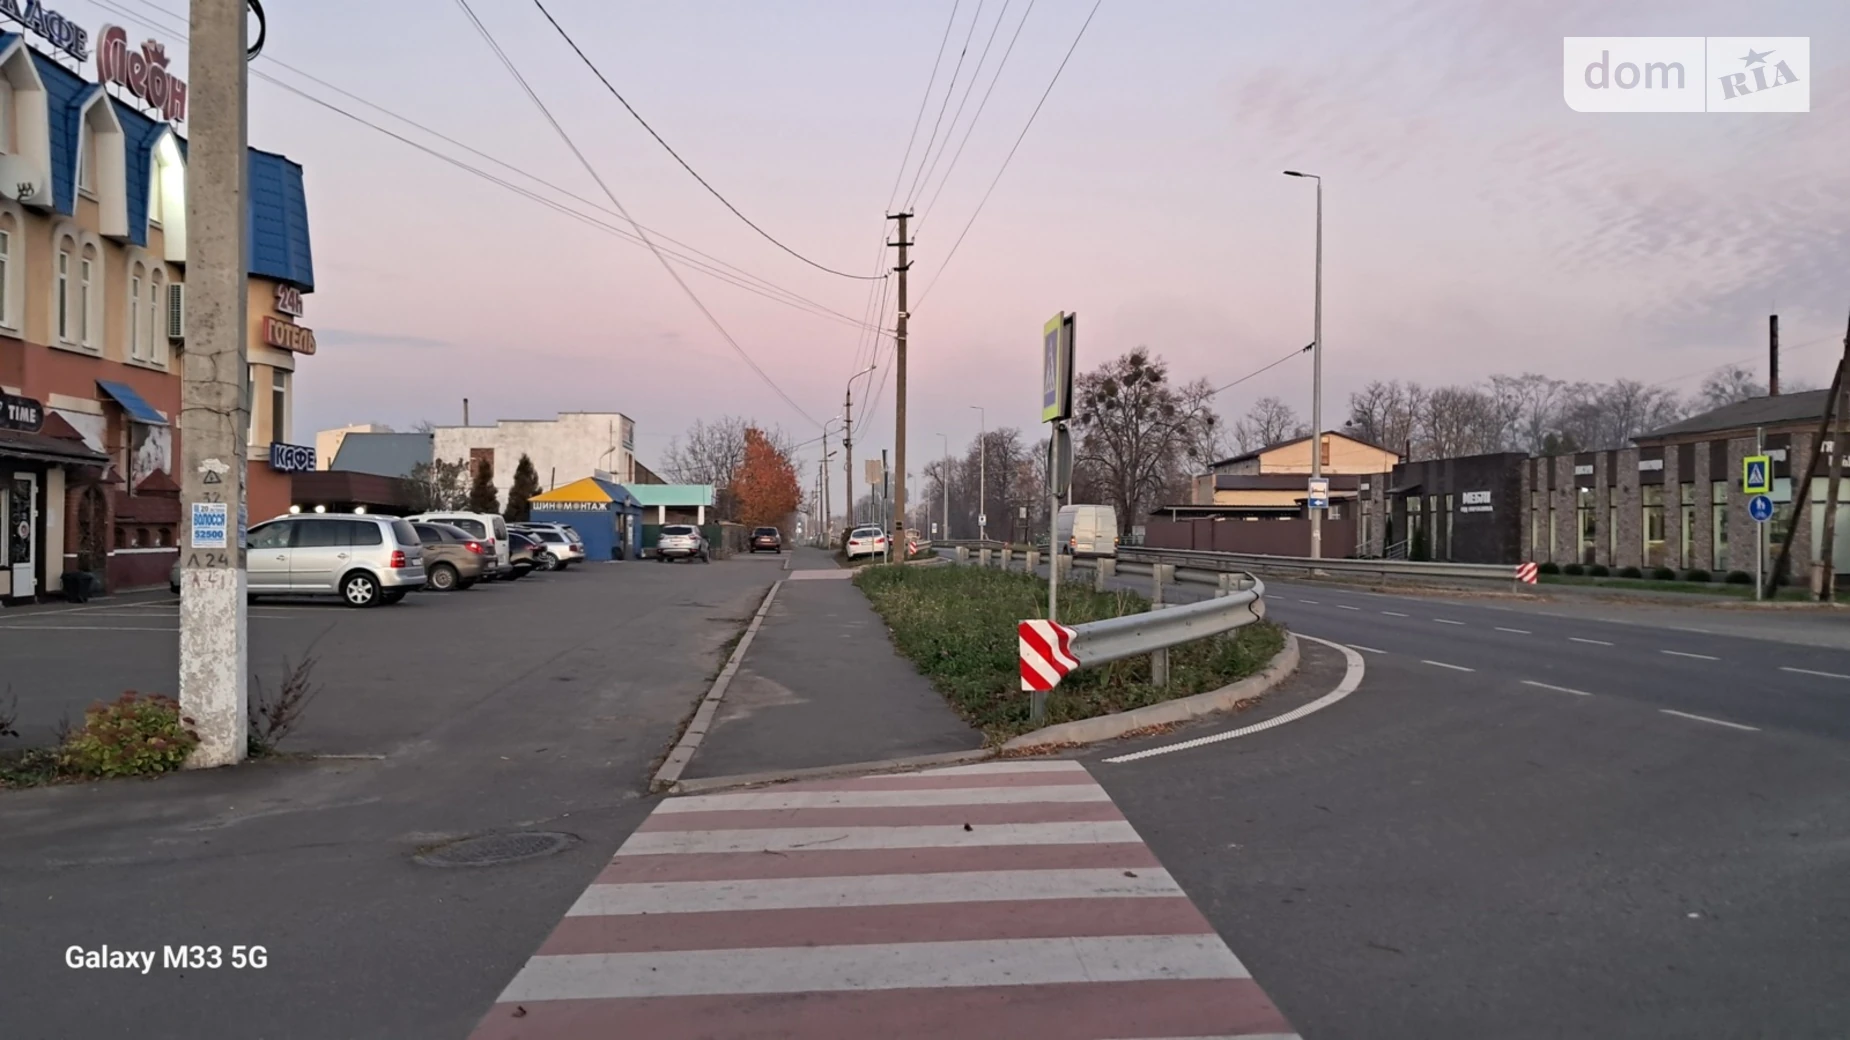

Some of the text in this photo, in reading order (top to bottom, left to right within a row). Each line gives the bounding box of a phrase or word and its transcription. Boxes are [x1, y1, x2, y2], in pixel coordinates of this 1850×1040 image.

[268, 319, 316, 354] ГОТЕЛЬ
[8, 405, 37, 423] TIME
[275, 444, 315, 471] КАФЕ
[193, 513, 225, 526] ВОЛОССЯ
[194, 530, 224, 538] 52500
[205, 553, 228, 568] 24
